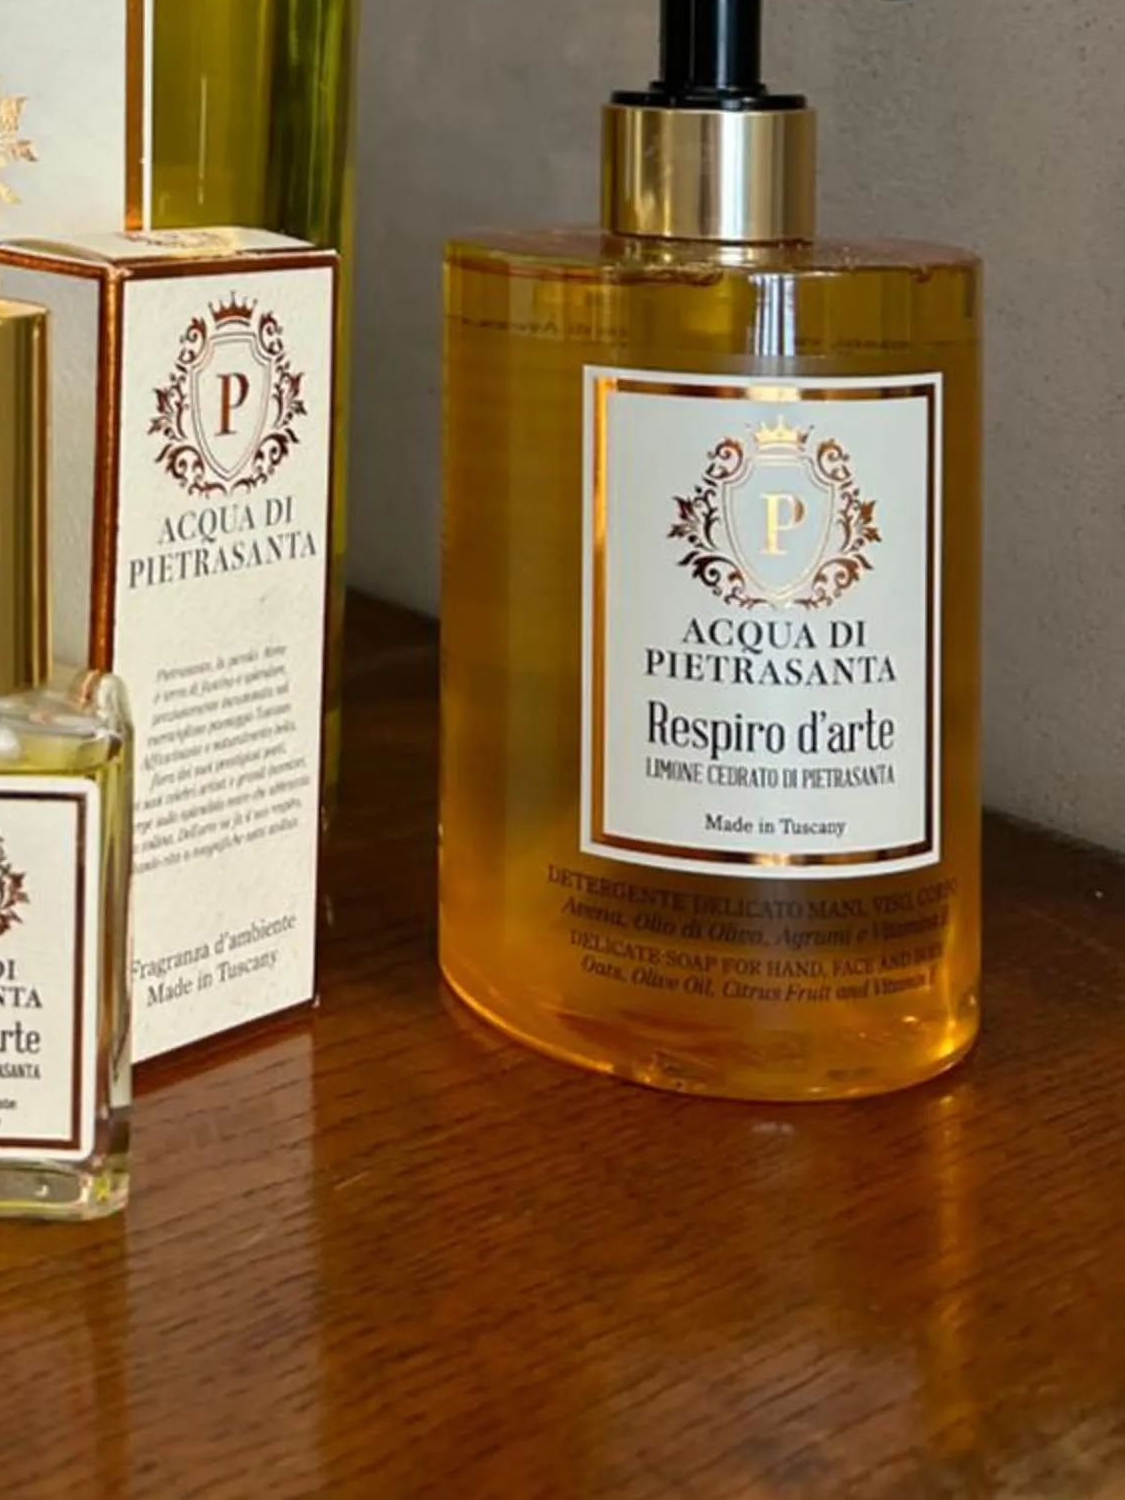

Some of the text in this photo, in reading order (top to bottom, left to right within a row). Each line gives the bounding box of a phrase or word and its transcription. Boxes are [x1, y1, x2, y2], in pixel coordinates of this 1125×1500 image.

[214, 371, 250, 437] P
[158, 496, 293, 546] ACQUA DI
[761, 493, 805, 556] P
[128, 531, 317, 589] PIETRASANTA
[682, 617, 866, 654] ACQUA DI
[644, 648, 897, 686] PIETRASANTA
[647, 700, 894, 760] Respiro d'arte
[645, 756, 895, 790] LIMONE CEDRATO DI PIETRASANTA
[704, 813, 846, 837] Made in Tuscany
[548, 864, 686, 911] DETERGENTE
[693, 895, 803, 919] DELICATO
[214, 914, 297, 954] d'ambiente
[570, 929, 660, 965] DELICATE
[666, 949, 717, 972] SOAP
[721, 957, 762, 976] FOR
[833, 956, 875, 976] FACE
[681, 917, 702, 937] di
[776, 924, 851, 949] Agrumi
[146, 948, 279, 1007] Made in Tuscany
[631, 964, 679, 990] Olive
[722, 979, 780, 1000] Citrus
[785, 983, 831, 1001] Fruit
[836, 980, 869, 999] and
